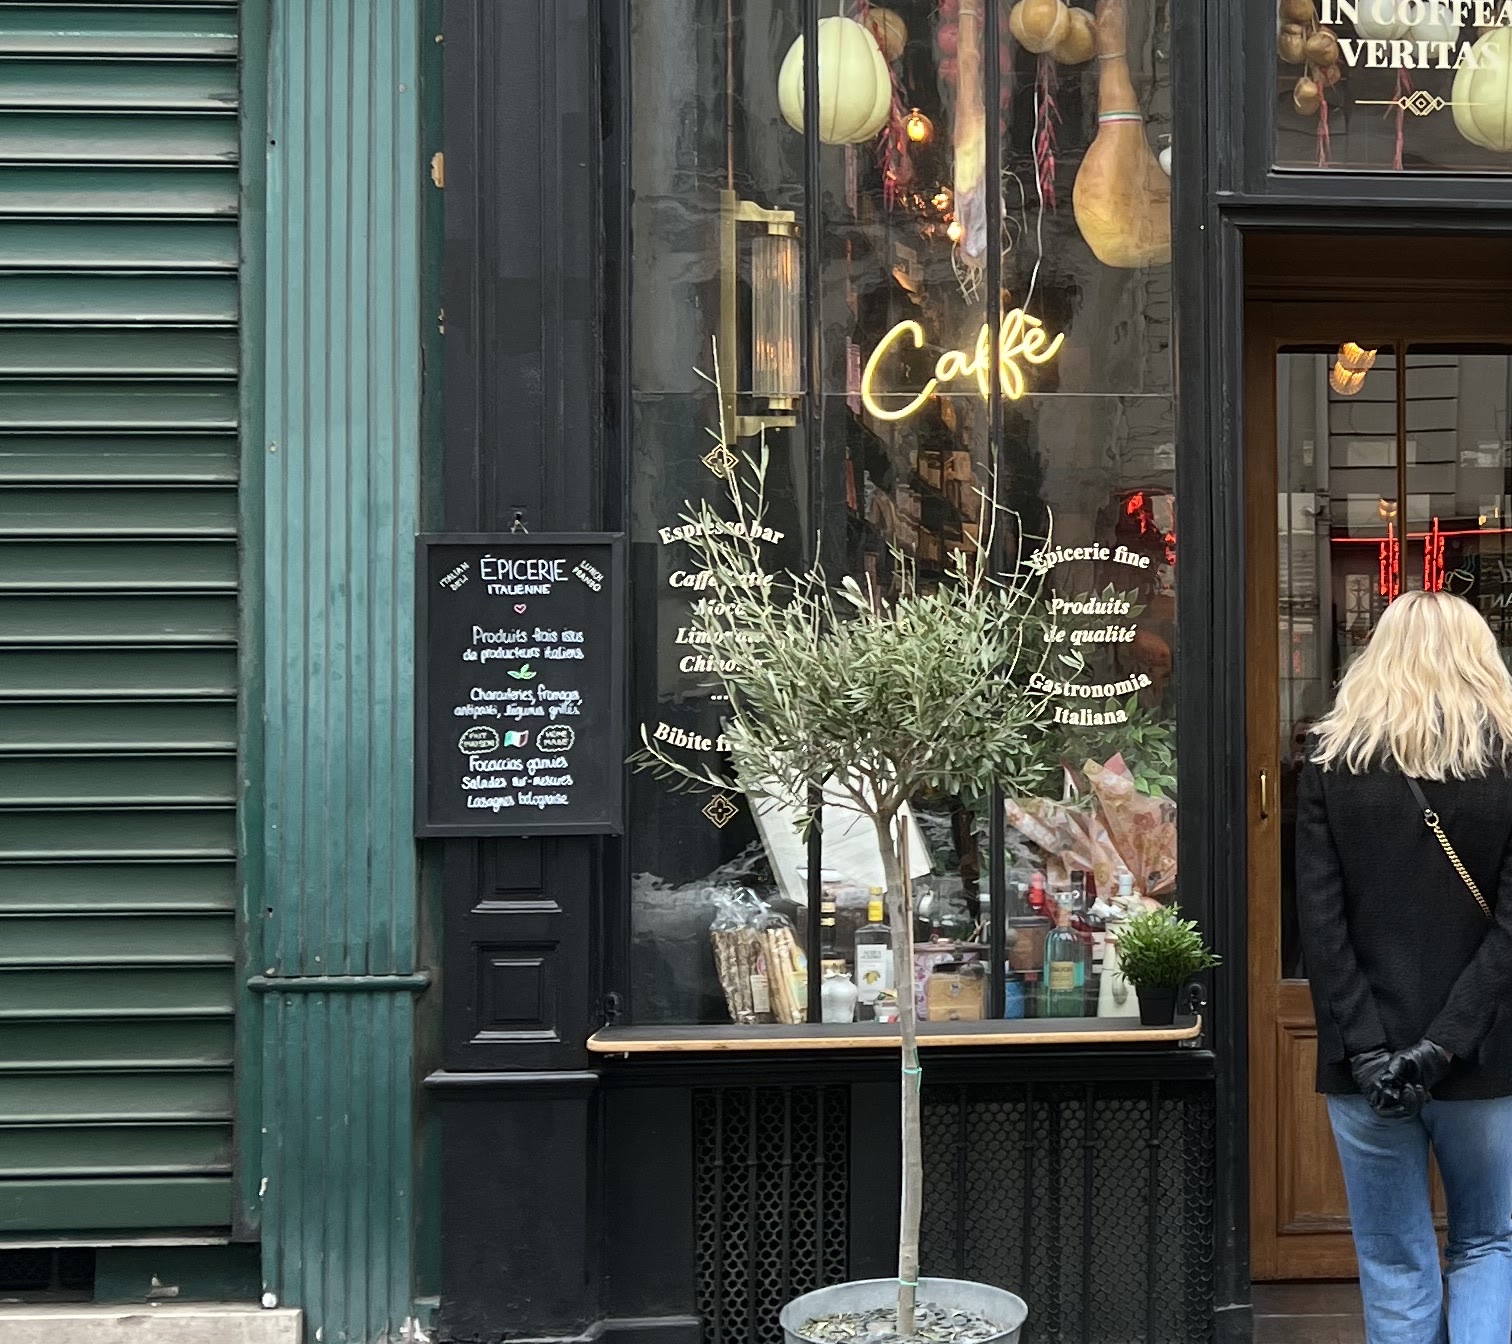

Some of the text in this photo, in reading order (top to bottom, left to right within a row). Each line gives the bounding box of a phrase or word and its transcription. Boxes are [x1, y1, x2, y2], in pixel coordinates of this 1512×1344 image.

[1337, 39, 1501, 70] VERITAS
[860, 307, 1066, 421] Caffè
[658, 519, 785, 545] Espresso bar
[480, 554, 569, 583] ÉPICERIE
[1113, 545, 1150, 569] fine
[1048, 597, 1131, 615] Produits
[472, 625, 528, 645] Produits
[1043, 624, 1137, 646] de qualité
[1028, 672, 1153, 698] Gastronomia
[1052, 706, 1129, 727] Italiana
[653, 721, 712, 752] Bibite
[469, 754, 524, 772] Focaccias
[461, 775, 508, 791] Salades
